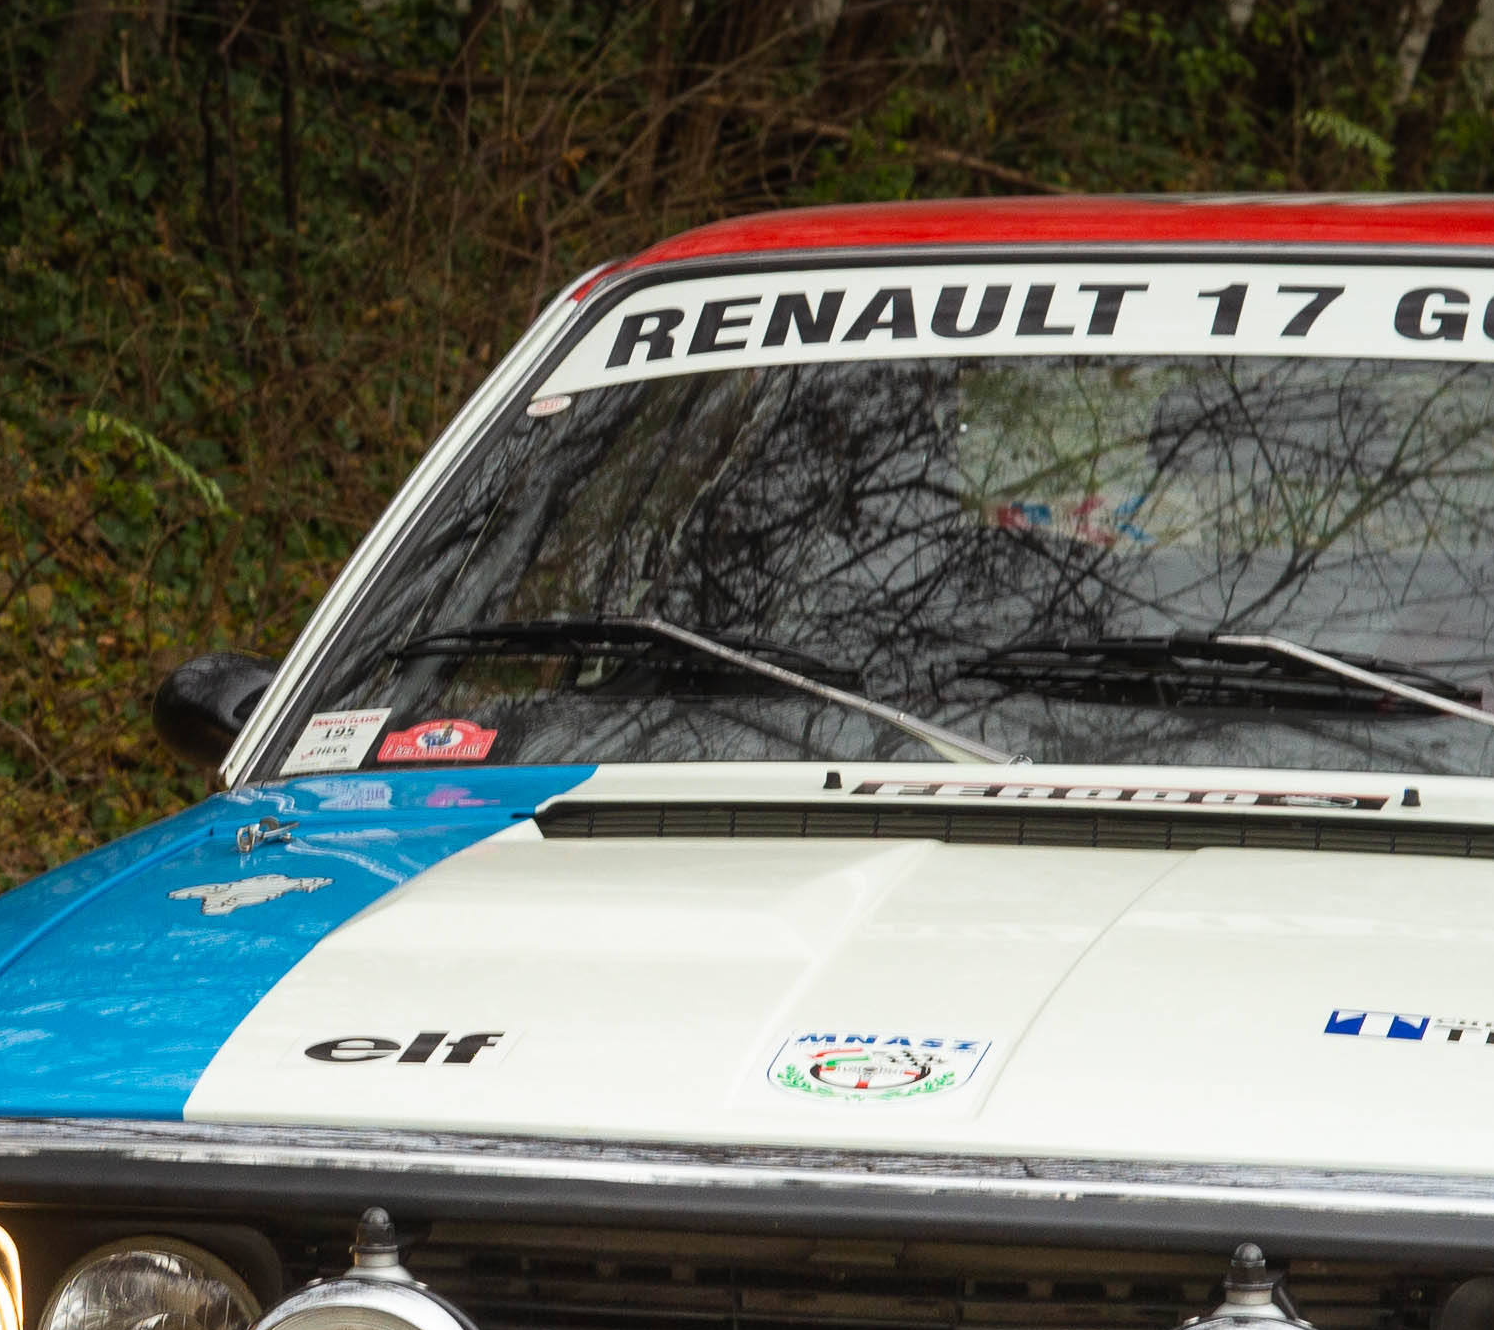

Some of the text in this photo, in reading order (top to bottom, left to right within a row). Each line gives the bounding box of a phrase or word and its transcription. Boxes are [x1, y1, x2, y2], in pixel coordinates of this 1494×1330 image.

[605, 283, 1149, 369] RENAULT
[1196, 283, 1344, 337] 17
[324, 726, 356, 740] 195
[303, 1030, 506, 1065] elf
[796, 1033, 980, 1051] MNASZ
